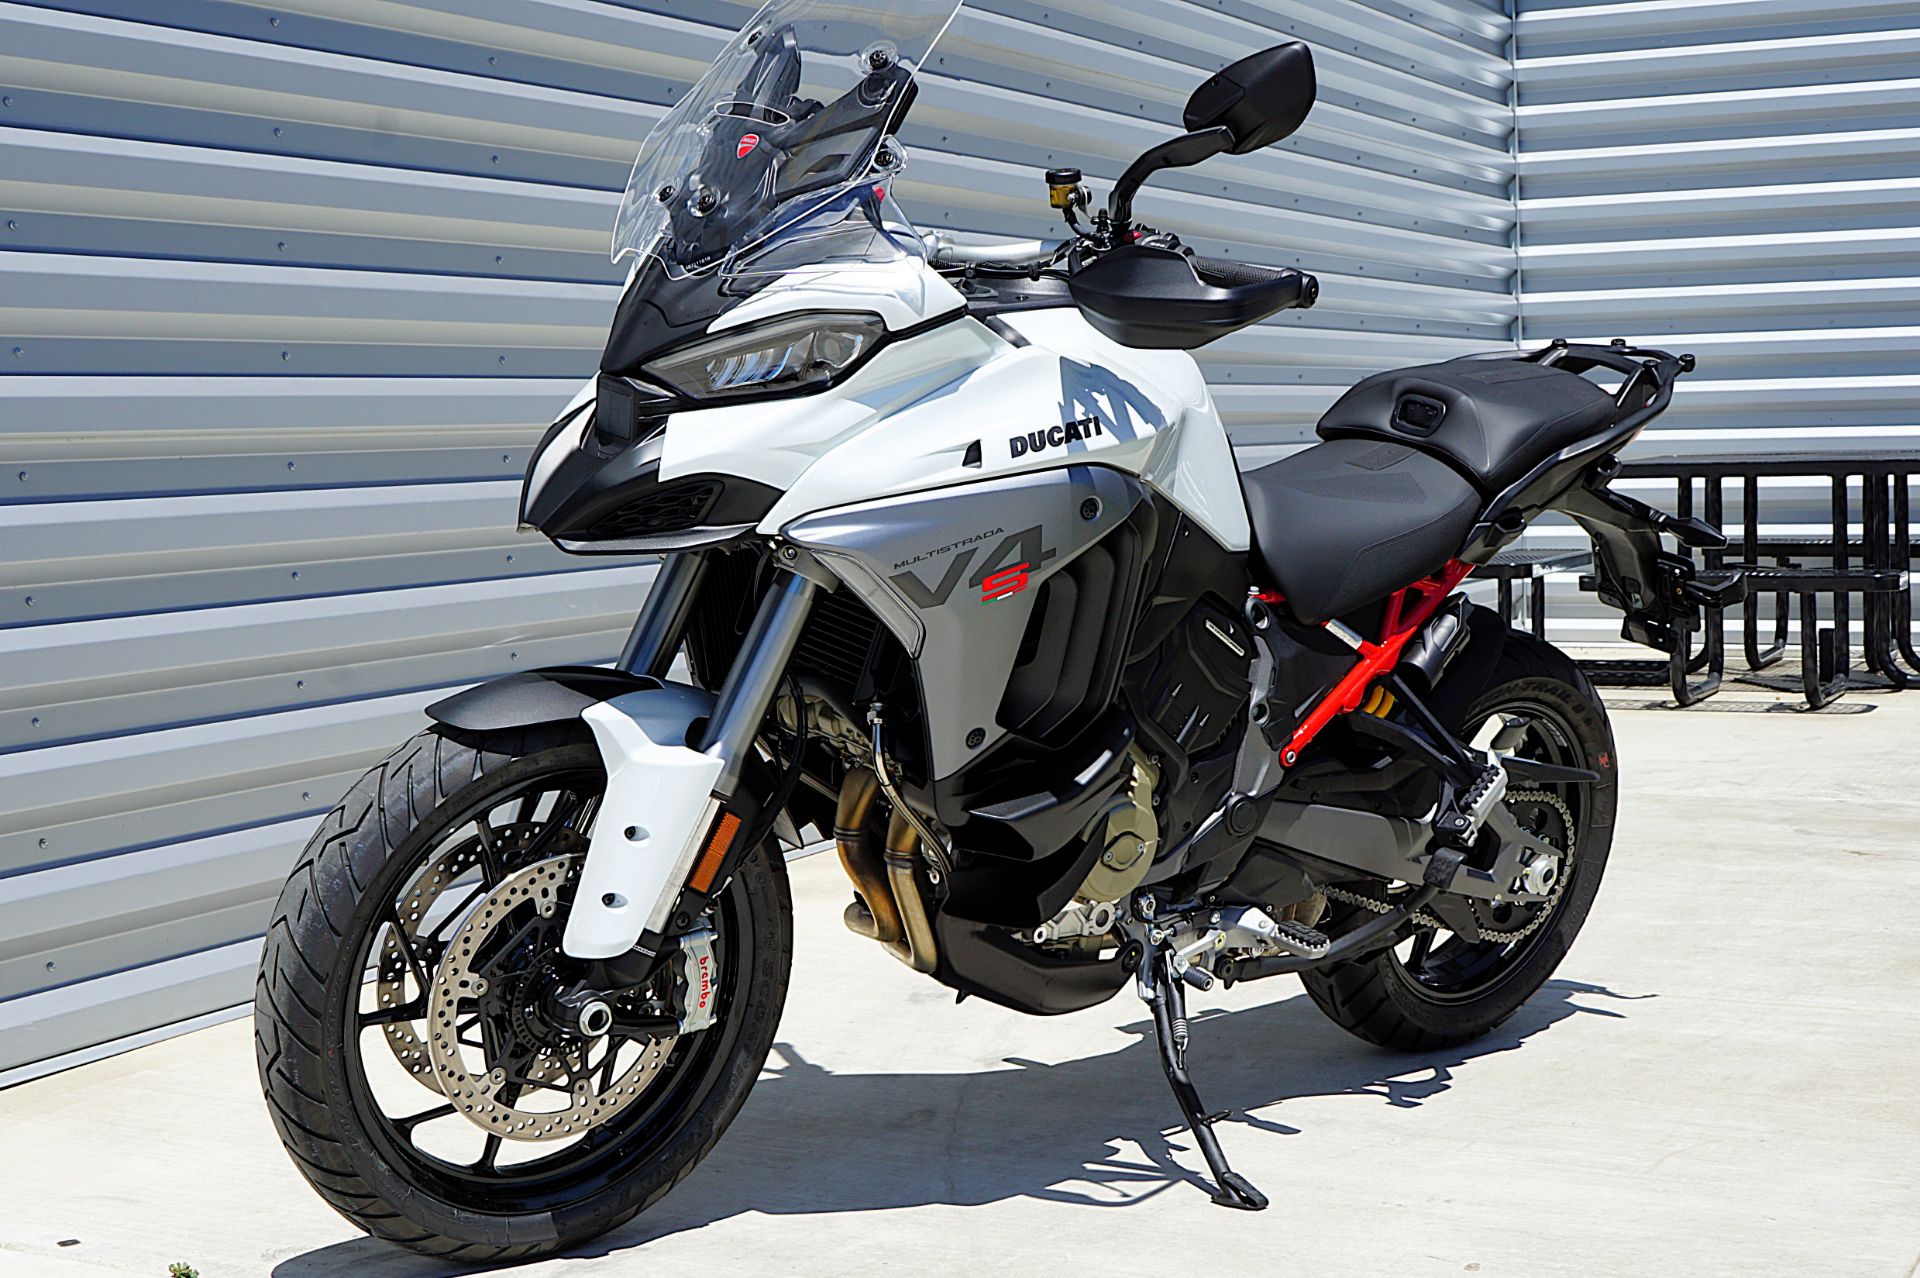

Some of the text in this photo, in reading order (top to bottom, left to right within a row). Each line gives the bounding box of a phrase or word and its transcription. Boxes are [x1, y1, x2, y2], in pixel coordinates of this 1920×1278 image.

[1009, 416, 1102, 459] DUCATI
[893, 527, 1004, 570] MULTISTRADA
[699, 956, 711, 1008] brembo
